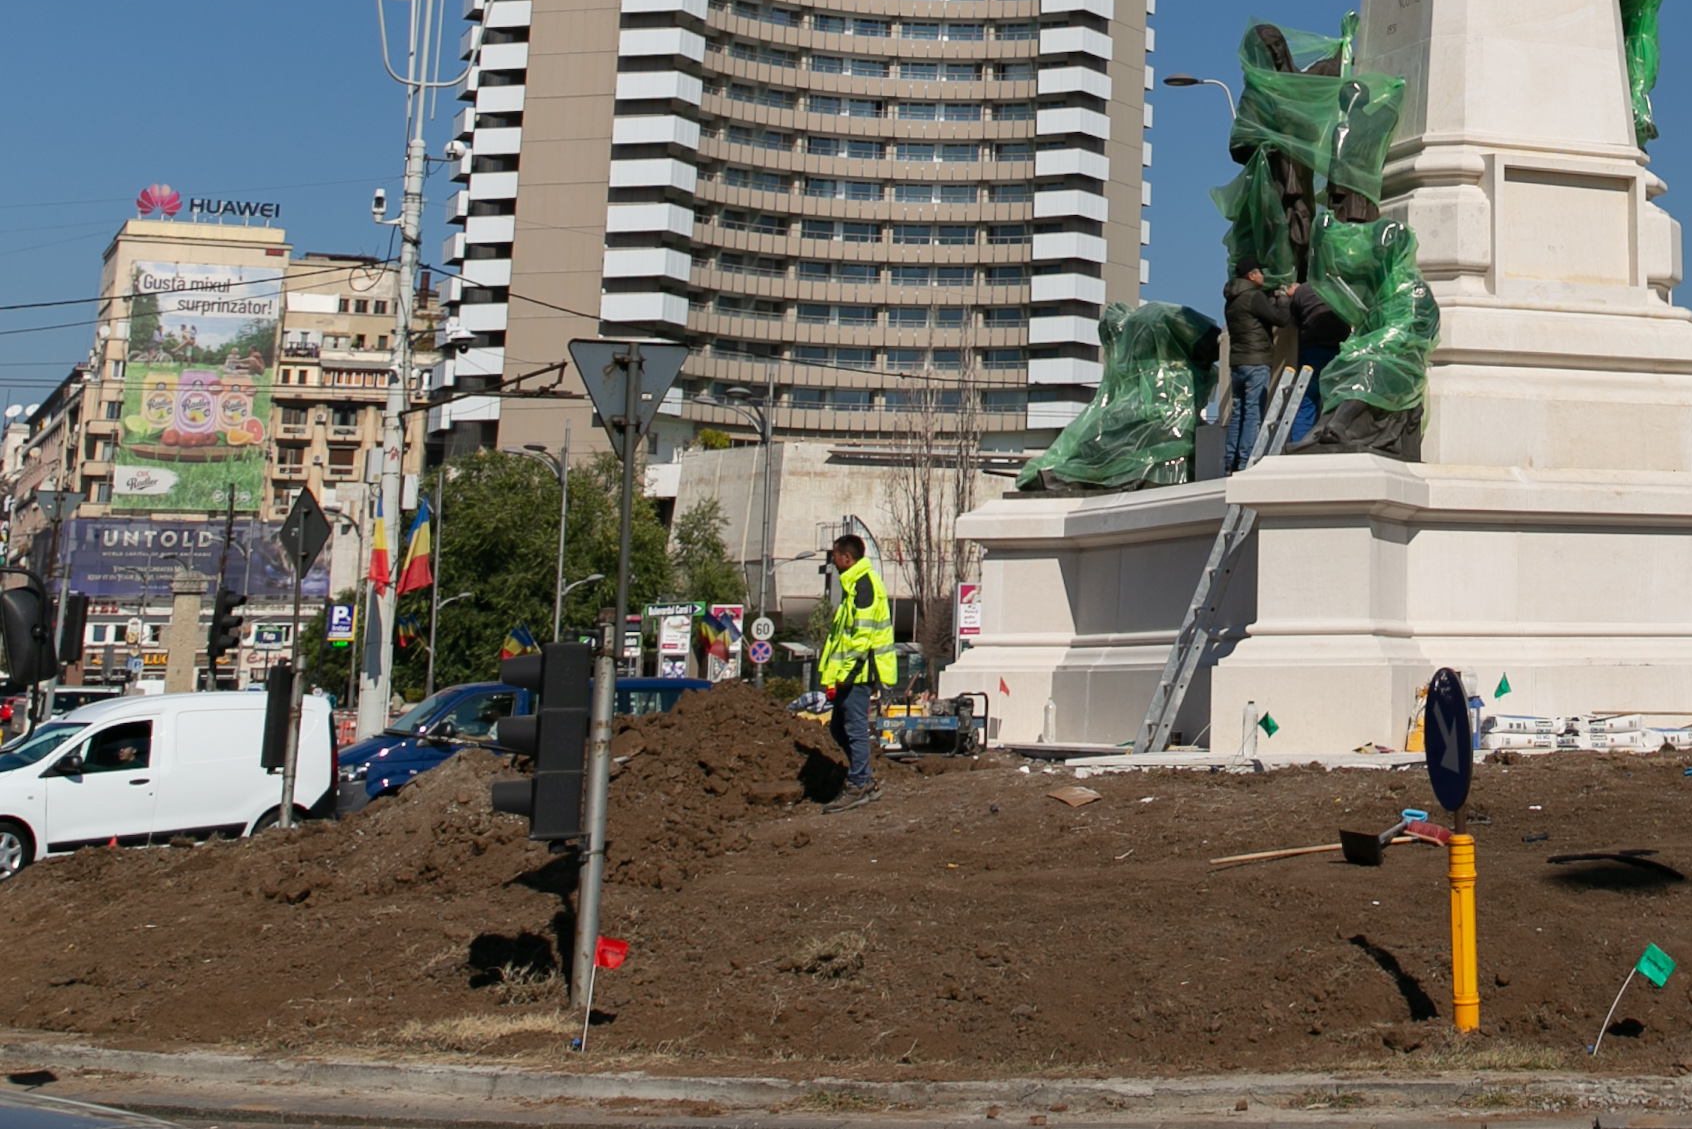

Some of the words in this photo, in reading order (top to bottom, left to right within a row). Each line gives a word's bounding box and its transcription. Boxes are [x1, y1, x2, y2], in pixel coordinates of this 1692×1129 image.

[189, 197, 280, 218] HUAWEI
[143, 273, 186, 292] Gustă
[190, 276, 231, 293] mixul
[182, 397, 211, 412] Radler
[126, 476, 158, 491] Radler
[103, 529, 213, 548] UNTOLD
[756, 623, 770, 635] 60
